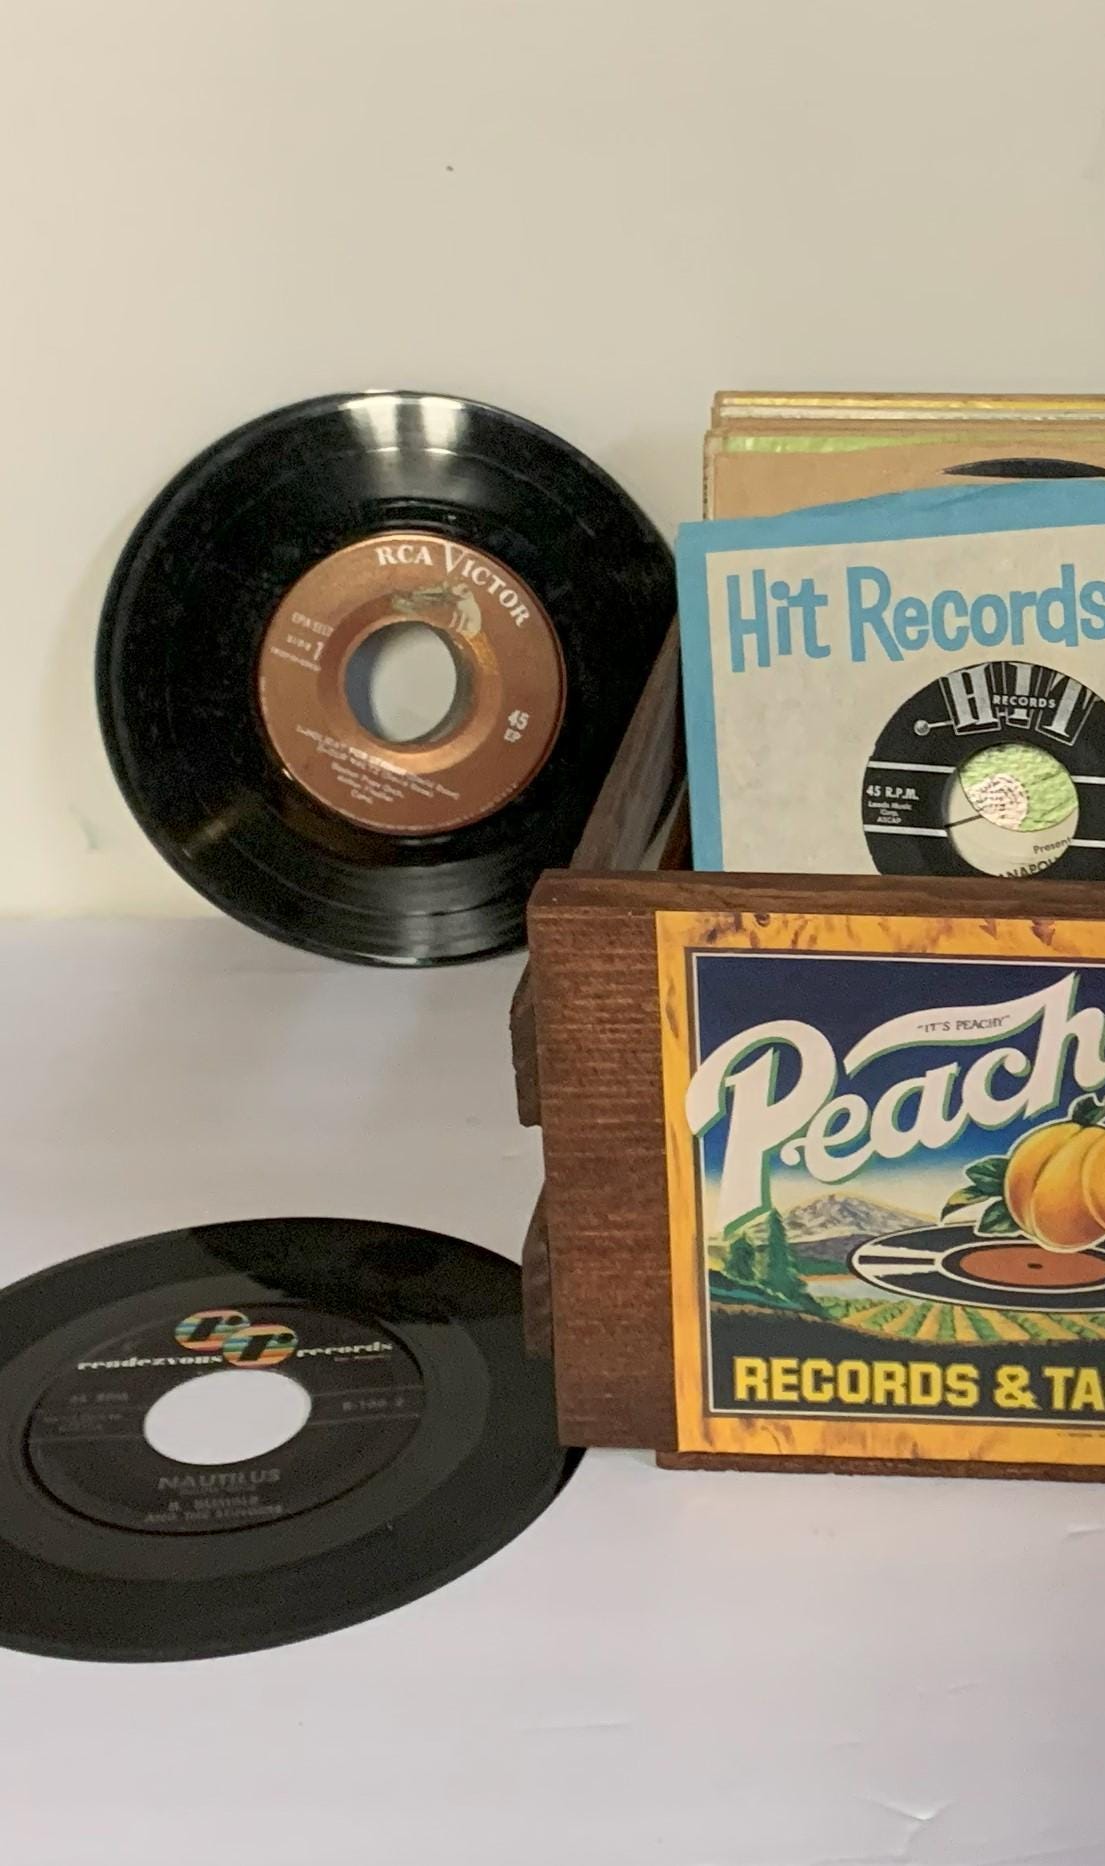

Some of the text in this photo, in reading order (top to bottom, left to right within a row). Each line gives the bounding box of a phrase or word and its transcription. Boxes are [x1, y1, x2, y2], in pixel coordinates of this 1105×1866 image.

[375, 542, 531, 628] RCA VICTOR
[726, 567, 831, 673] Hit
[947, 660, 1094, 738] HIT
[992, 694, 1056, 709] RECORDS
[507, 709, 530, 730] 45
[866, 785, 881, 797] 45
[297, 1341, 393, 1357] records
[734, 1356, 979, 1406] RECORDS
[993, 1363, 1043, 1411] &
